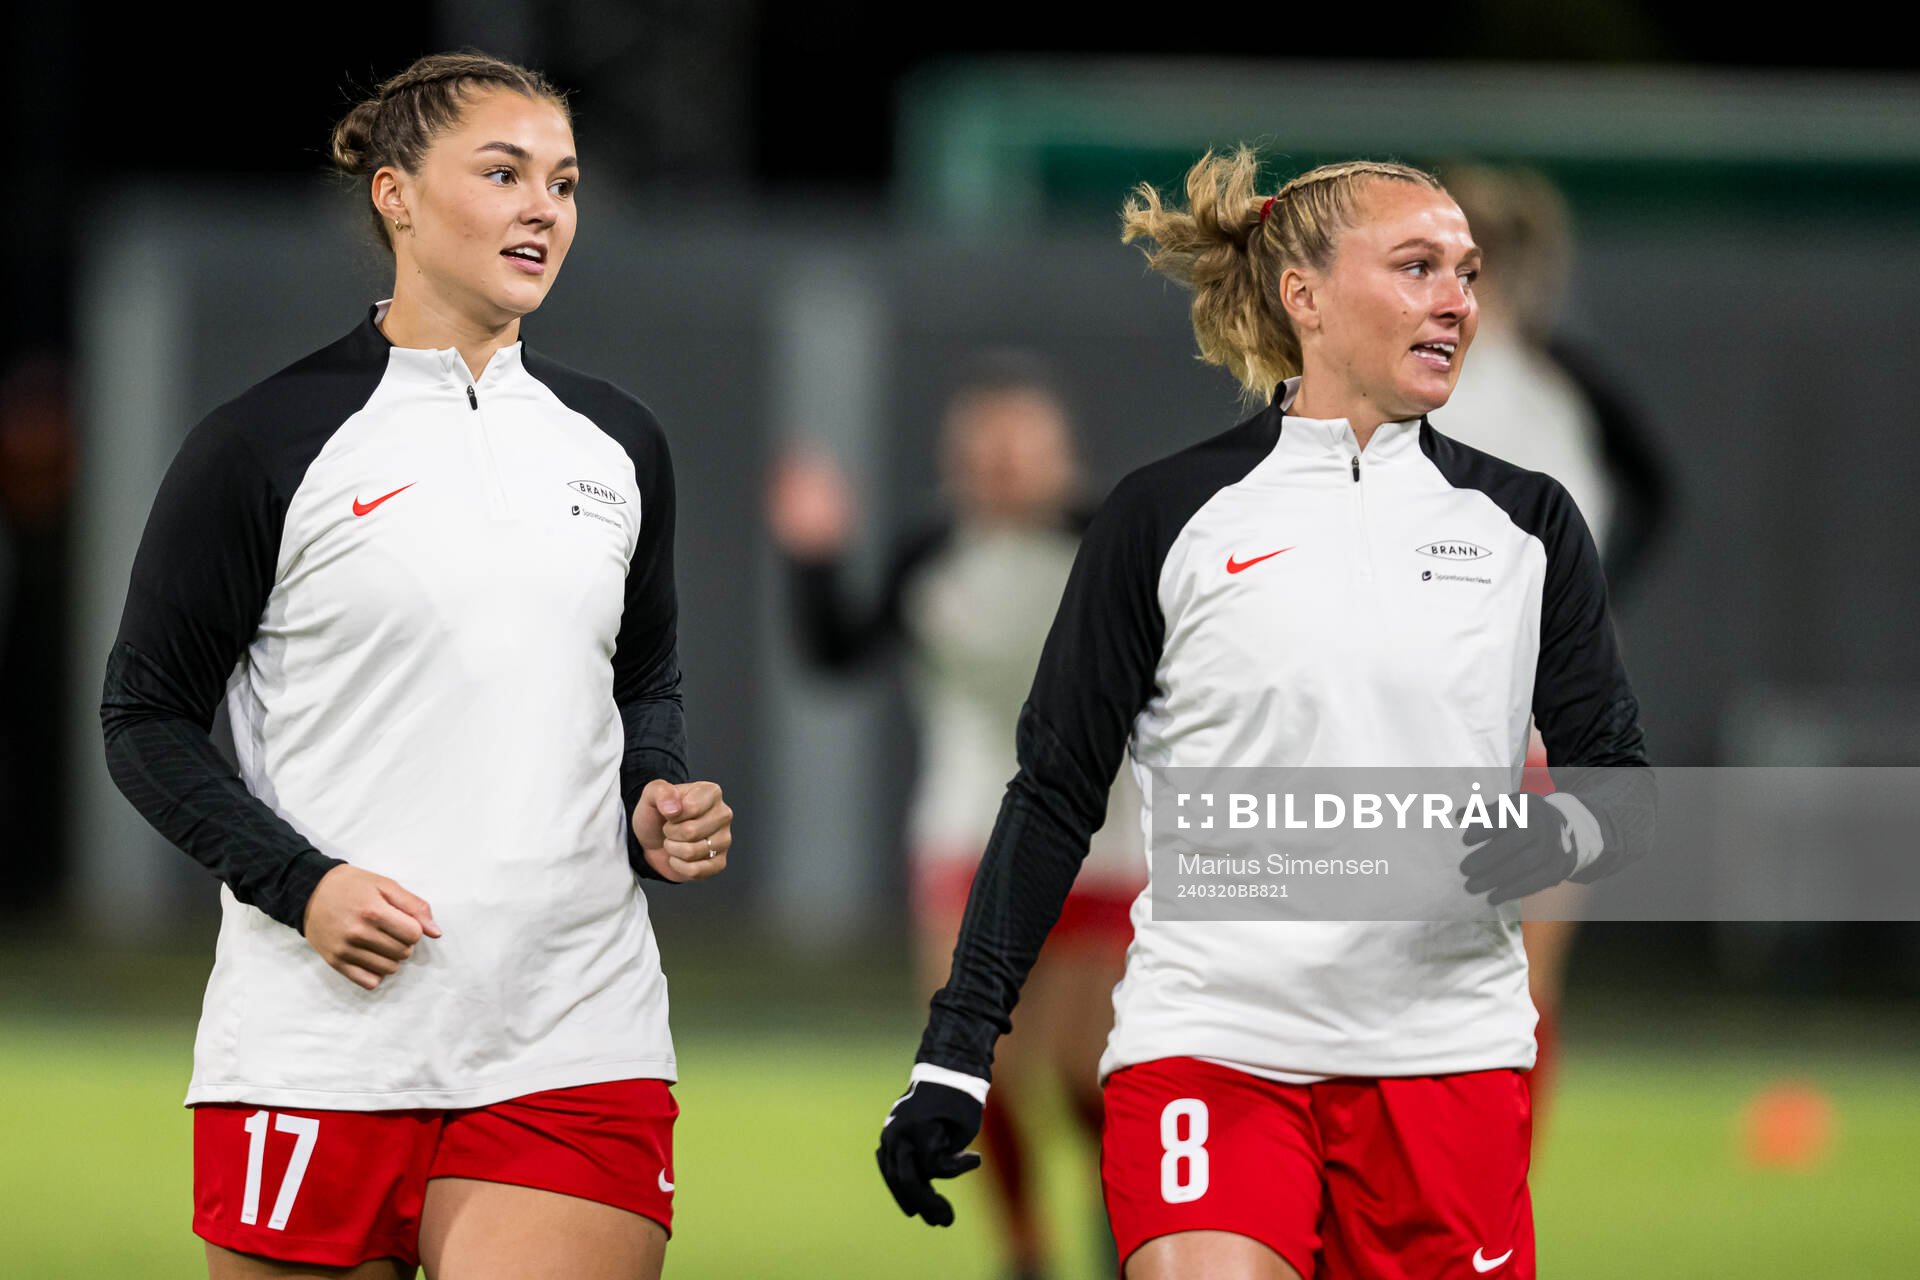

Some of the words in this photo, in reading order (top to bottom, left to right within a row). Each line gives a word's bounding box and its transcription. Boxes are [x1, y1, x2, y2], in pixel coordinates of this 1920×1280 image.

[579, 483, 616, 502] BRANN
[1431, 545, 1478, 556] BRANN
[240, 1110, 320, 1231] 17
[1160, 1098, 1209, 1204] 8
